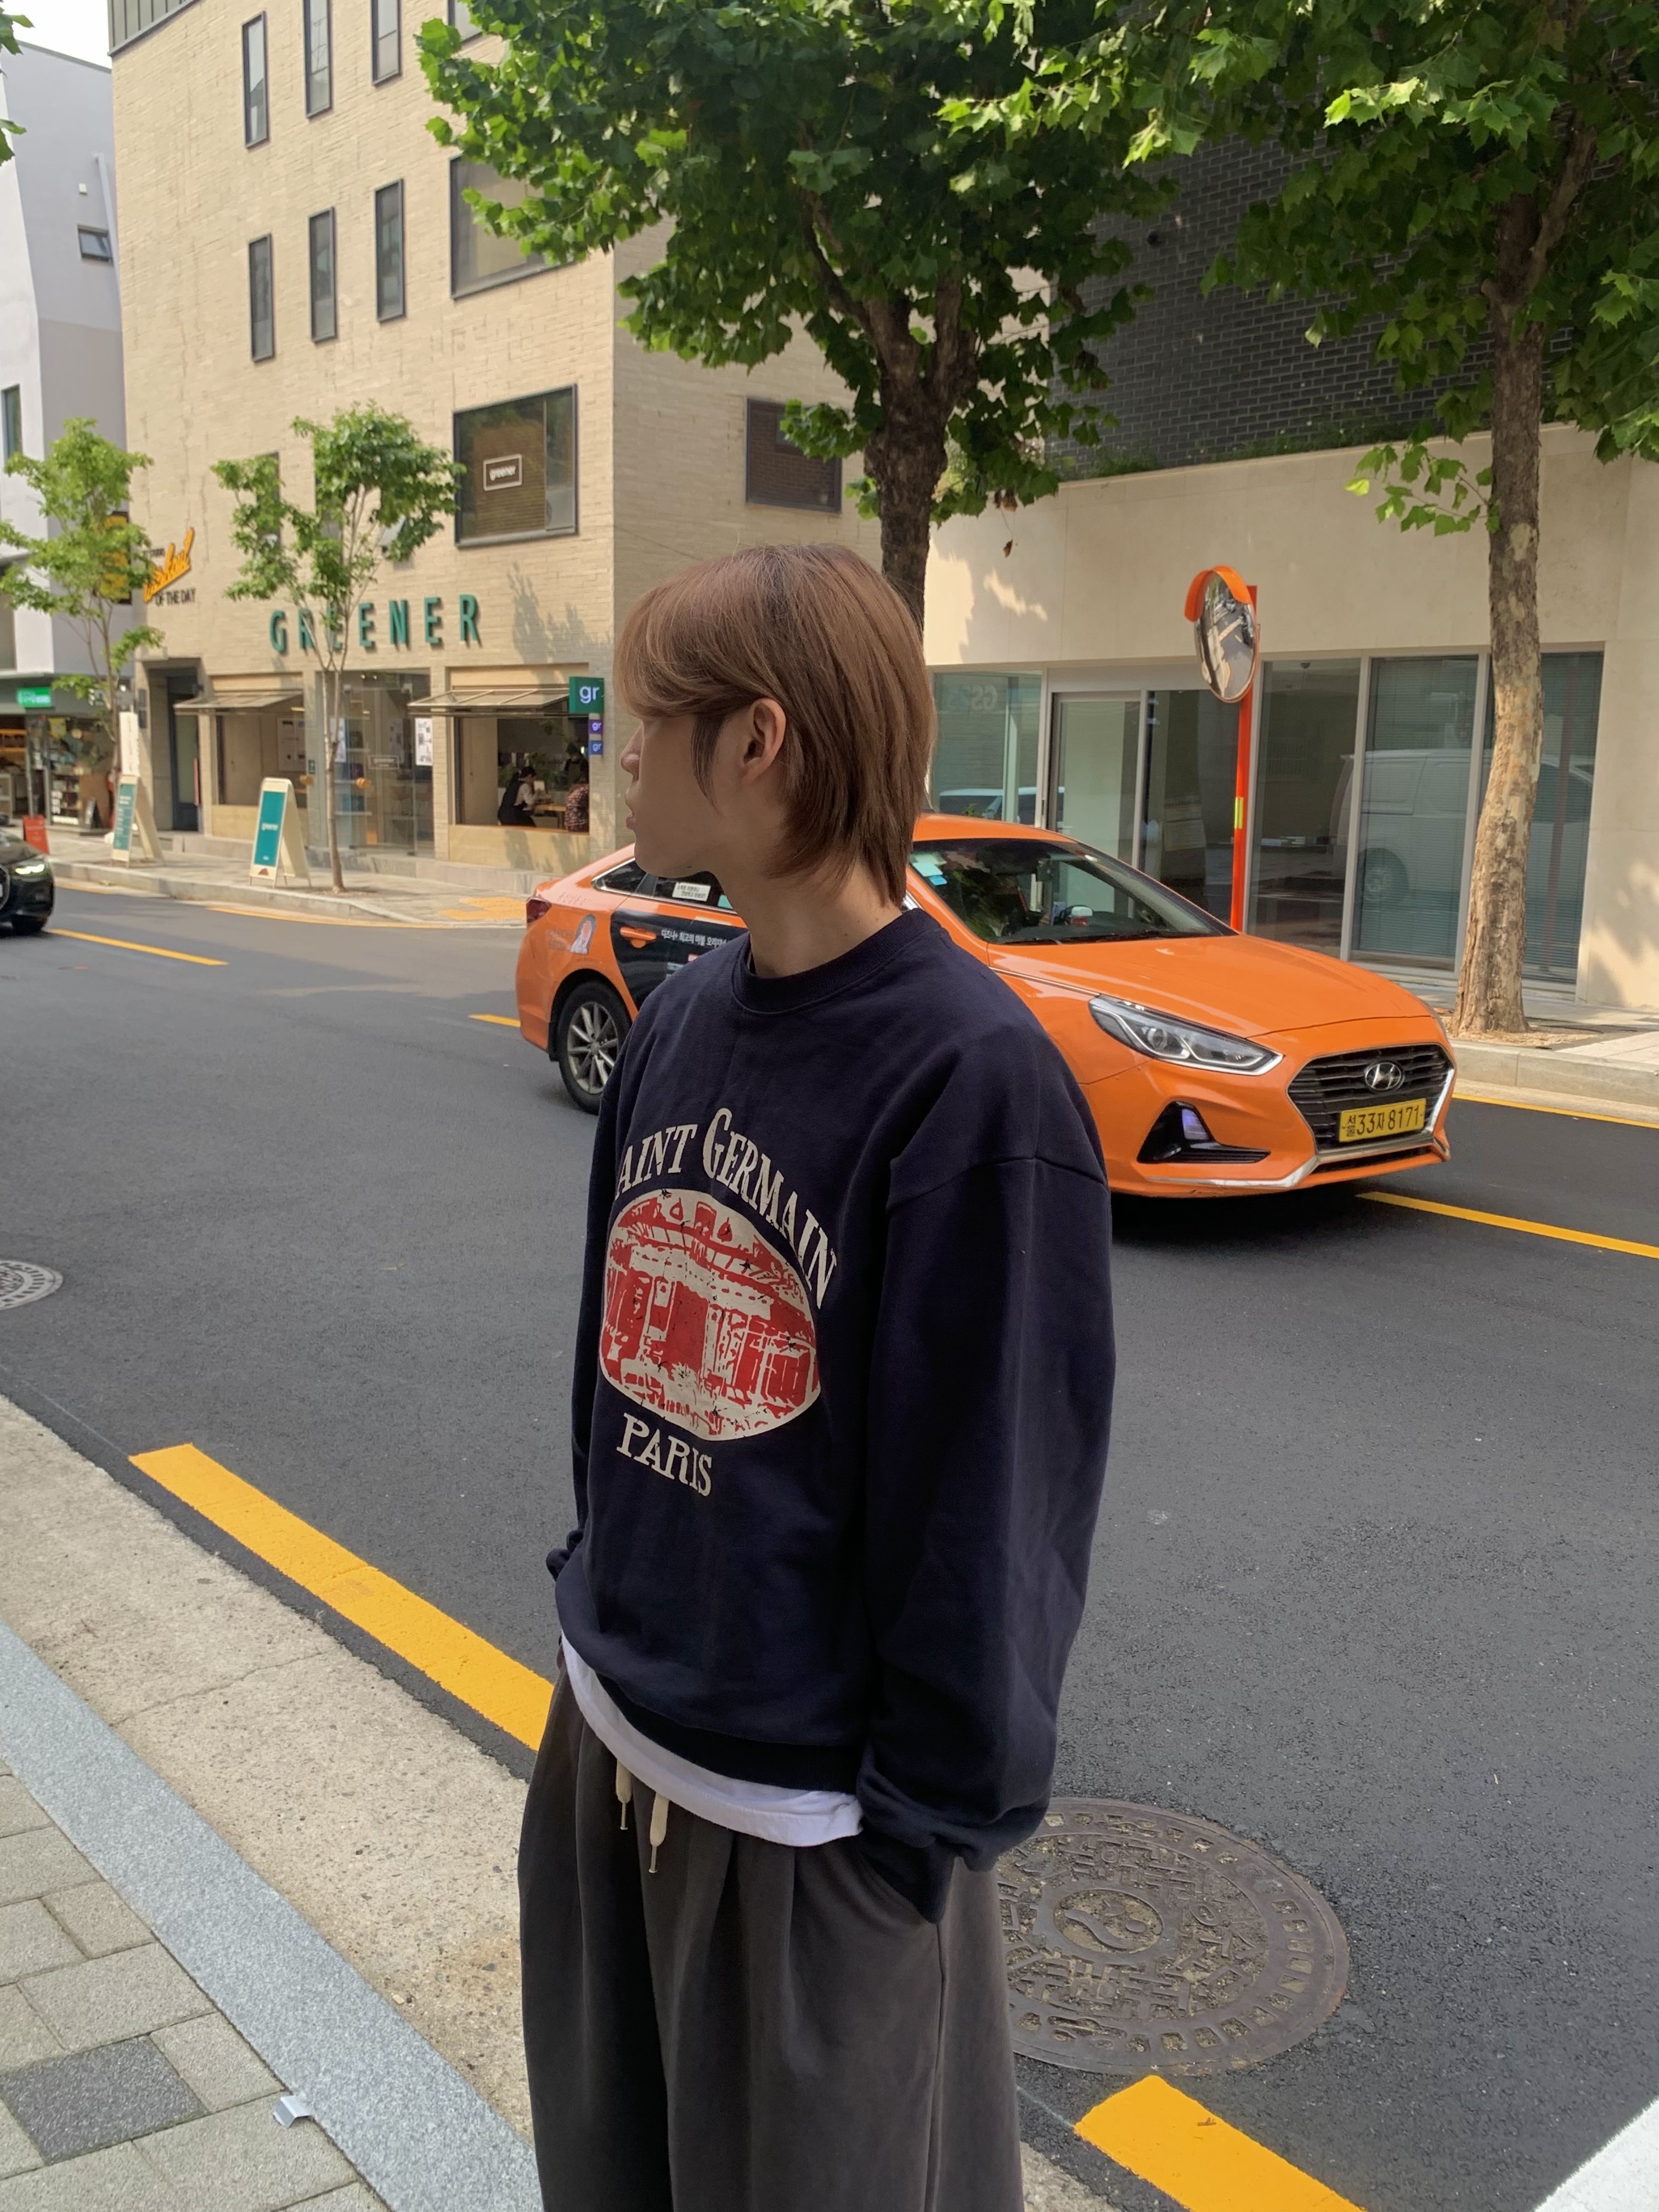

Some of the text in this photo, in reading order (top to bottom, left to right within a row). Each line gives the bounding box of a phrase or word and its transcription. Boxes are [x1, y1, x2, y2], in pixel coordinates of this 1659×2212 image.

[166, 590, 179, 605] THE
[181, 588, 196, 603] DAY
[579, 686, 600, 704] gr
[592, 722, 601, 731] gr
[592, 743, 601, 752] gr
[1388, 1105, 1419, 1130] 8171
[615, 1107, 837, 1310] AINT GERMAIN
[617, 1412, 712, 1497] PARIS
